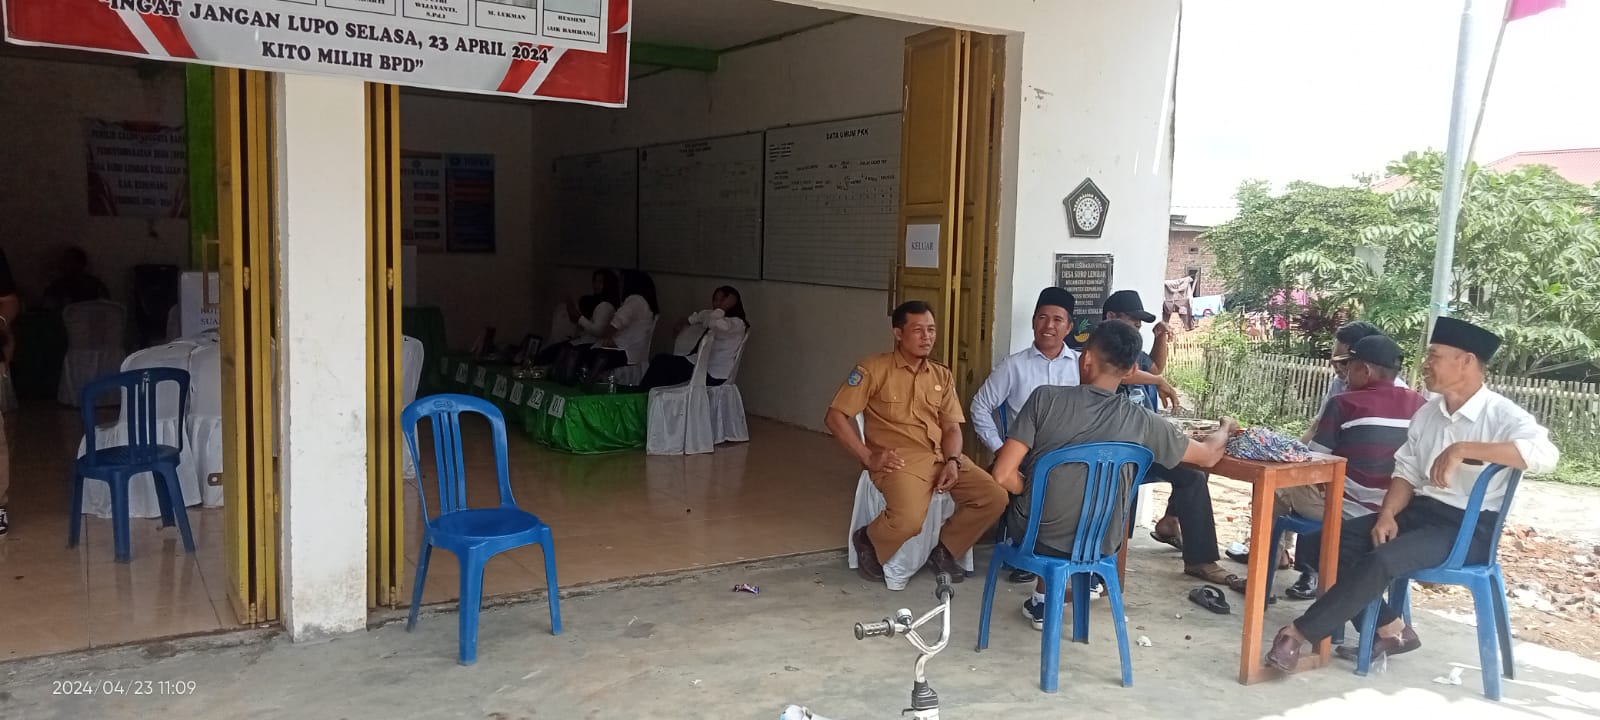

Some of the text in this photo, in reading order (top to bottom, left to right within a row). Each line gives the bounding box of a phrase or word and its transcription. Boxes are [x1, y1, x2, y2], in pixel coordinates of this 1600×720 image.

[497, 11, 527, 21] LUKMAN
[190, 3, 280, 28] JANGAN
[288, 14, 339, 36] LUPO
[345, 22, 422, 49] SELASA,
[428, 36, 449, 51] 23
[454, 37, 507, 57] APRIL
[511, 46, 549, 63] 2024
[261, 41, 311, 61] KITO
[317, 48, 373, 68] MILIH
[1061, 270, 1073, 279] DESA
[1074, 270, 1087, 279] SURO
